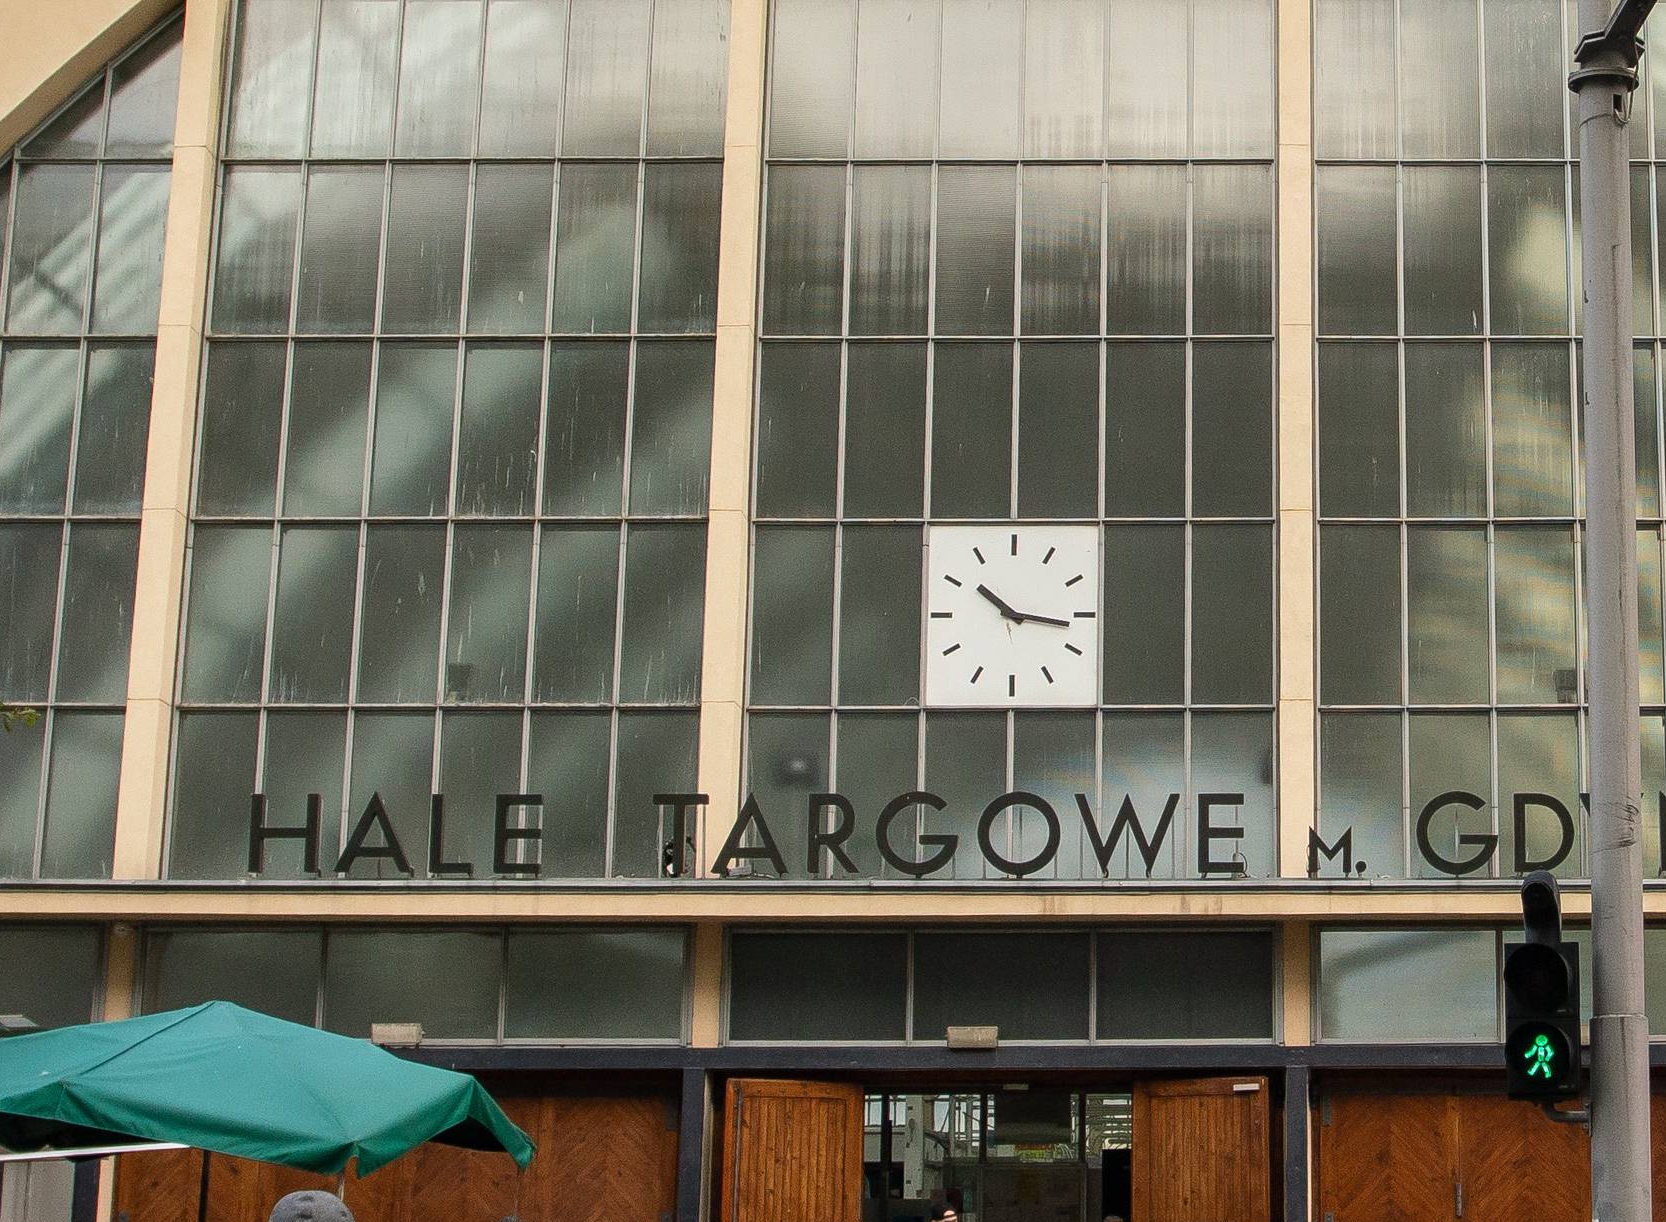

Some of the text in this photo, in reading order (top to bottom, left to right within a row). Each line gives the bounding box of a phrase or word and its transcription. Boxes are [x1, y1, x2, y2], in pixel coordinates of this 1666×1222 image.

[247, 791, 544, 875] HALE
[652, 791, 1246, 877] TARGOWE
[1307, 826, 1368, 879] M.
